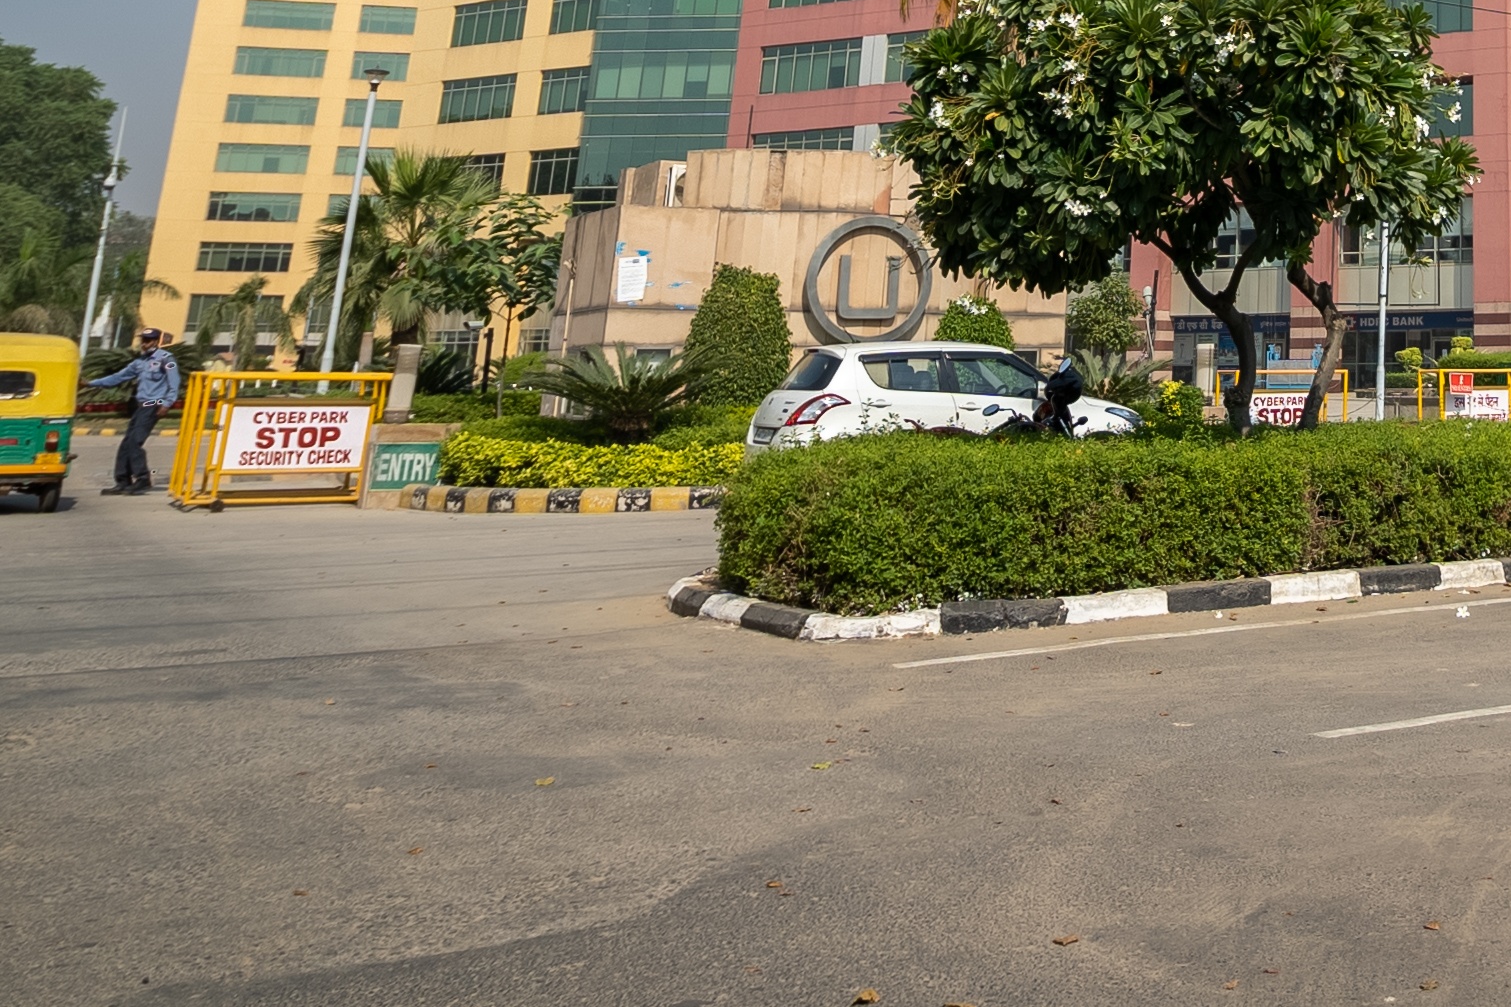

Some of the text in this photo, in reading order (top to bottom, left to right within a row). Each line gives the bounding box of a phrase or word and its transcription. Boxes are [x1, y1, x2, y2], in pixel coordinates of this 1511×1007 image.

[1392, 316, 1424, 326] BANK
[1253, 396, 1285, 407] CYBER
[252, 410, 350, 425] CYBER PARK
[1258, 407, 1304, 425] STOP
[255, 426, 341, 450] STOP
[238, 449, 352, 466] SECURITY CHECK
[375, 452, 437, 482] ENTRY
